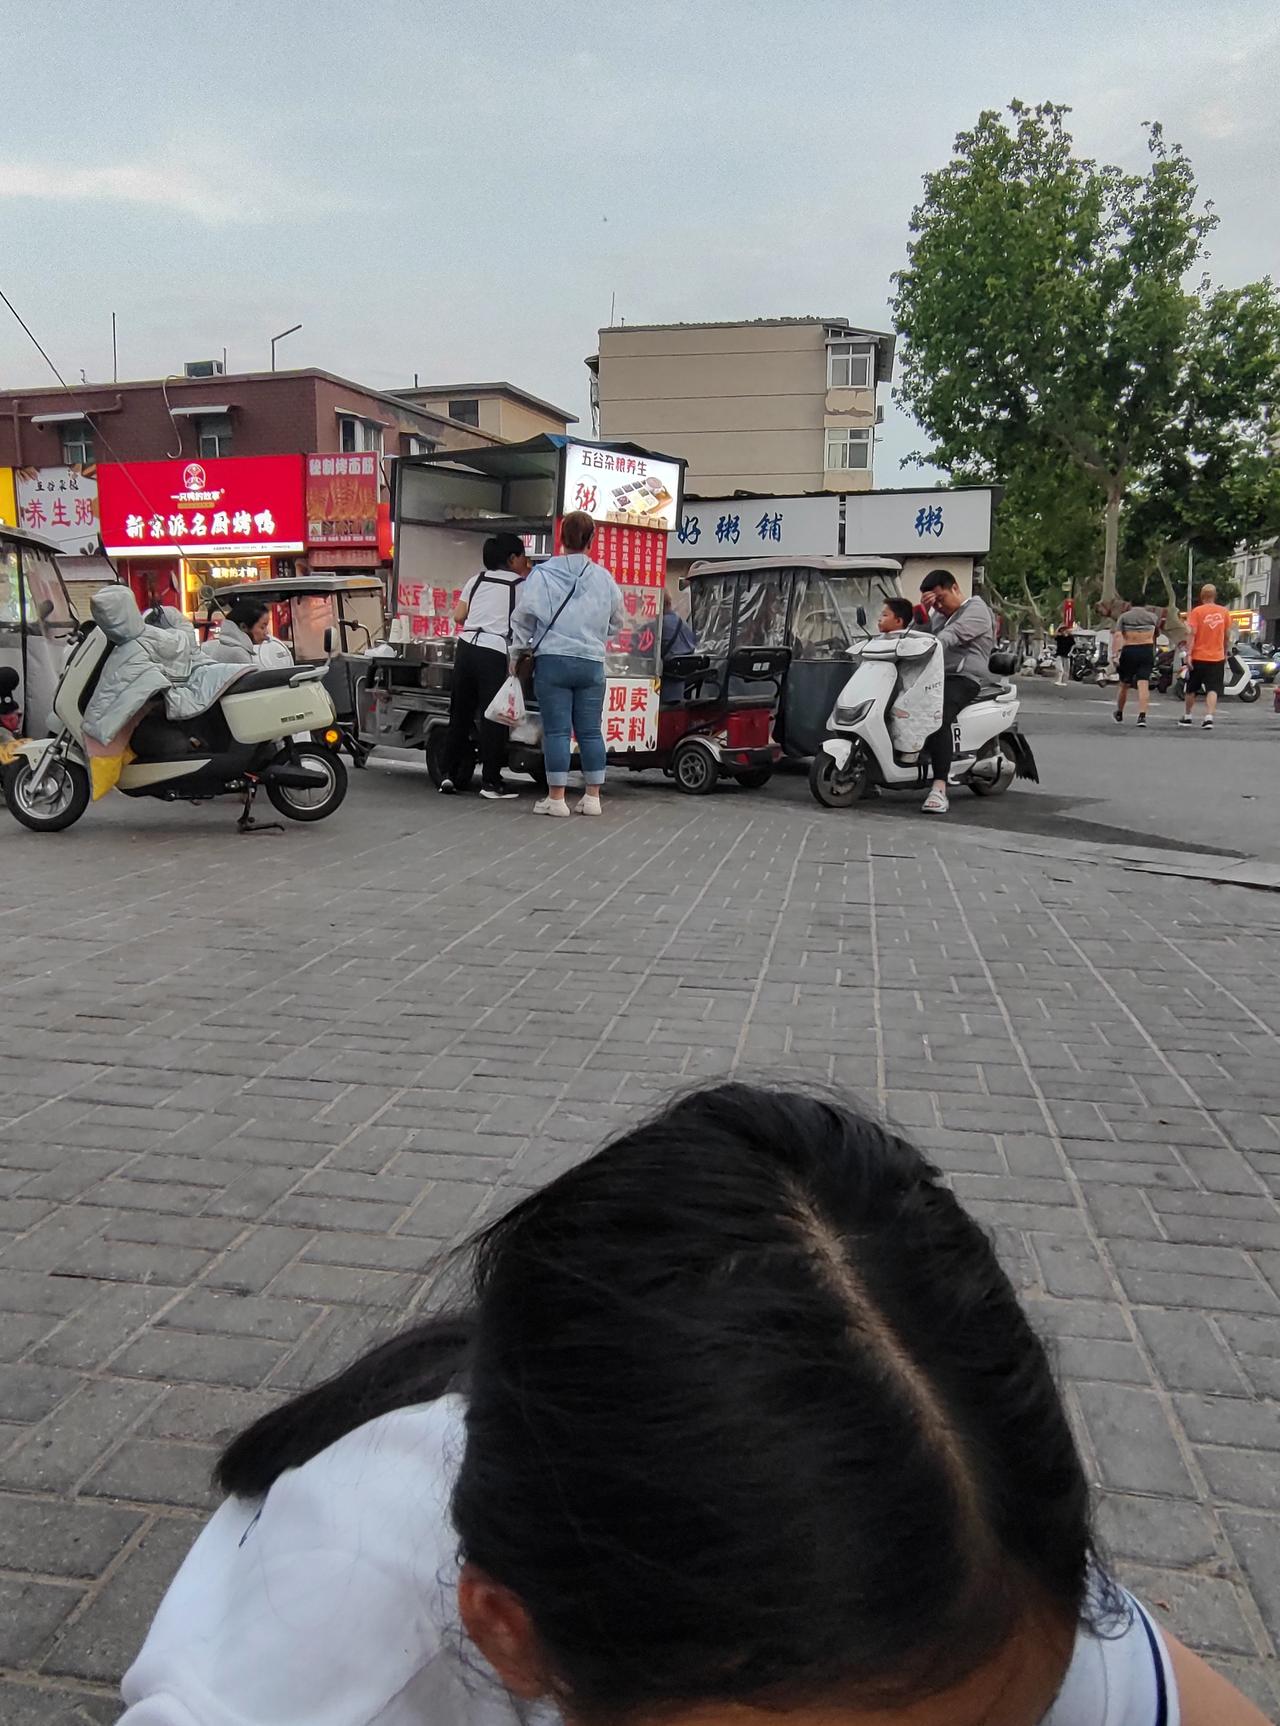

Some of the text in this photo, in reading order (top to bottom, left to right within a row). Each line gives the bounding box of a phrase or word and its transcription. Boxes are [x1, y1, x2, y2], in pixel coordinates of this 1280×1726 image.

[582, 449, 647, 477] 五谷杂粮养生
[24, 497, 94, 528] 养生粥
[575, 483, 597, 513] 粥
[126, 509, 276, 540] 新京派名厨烤鸭
[678, 512, 783, 545] 好粥铺
[914, 504, 945, 538] 粥
[608, 687, 648, 712] 现卖
[606, 716, 646, 742] 实料
